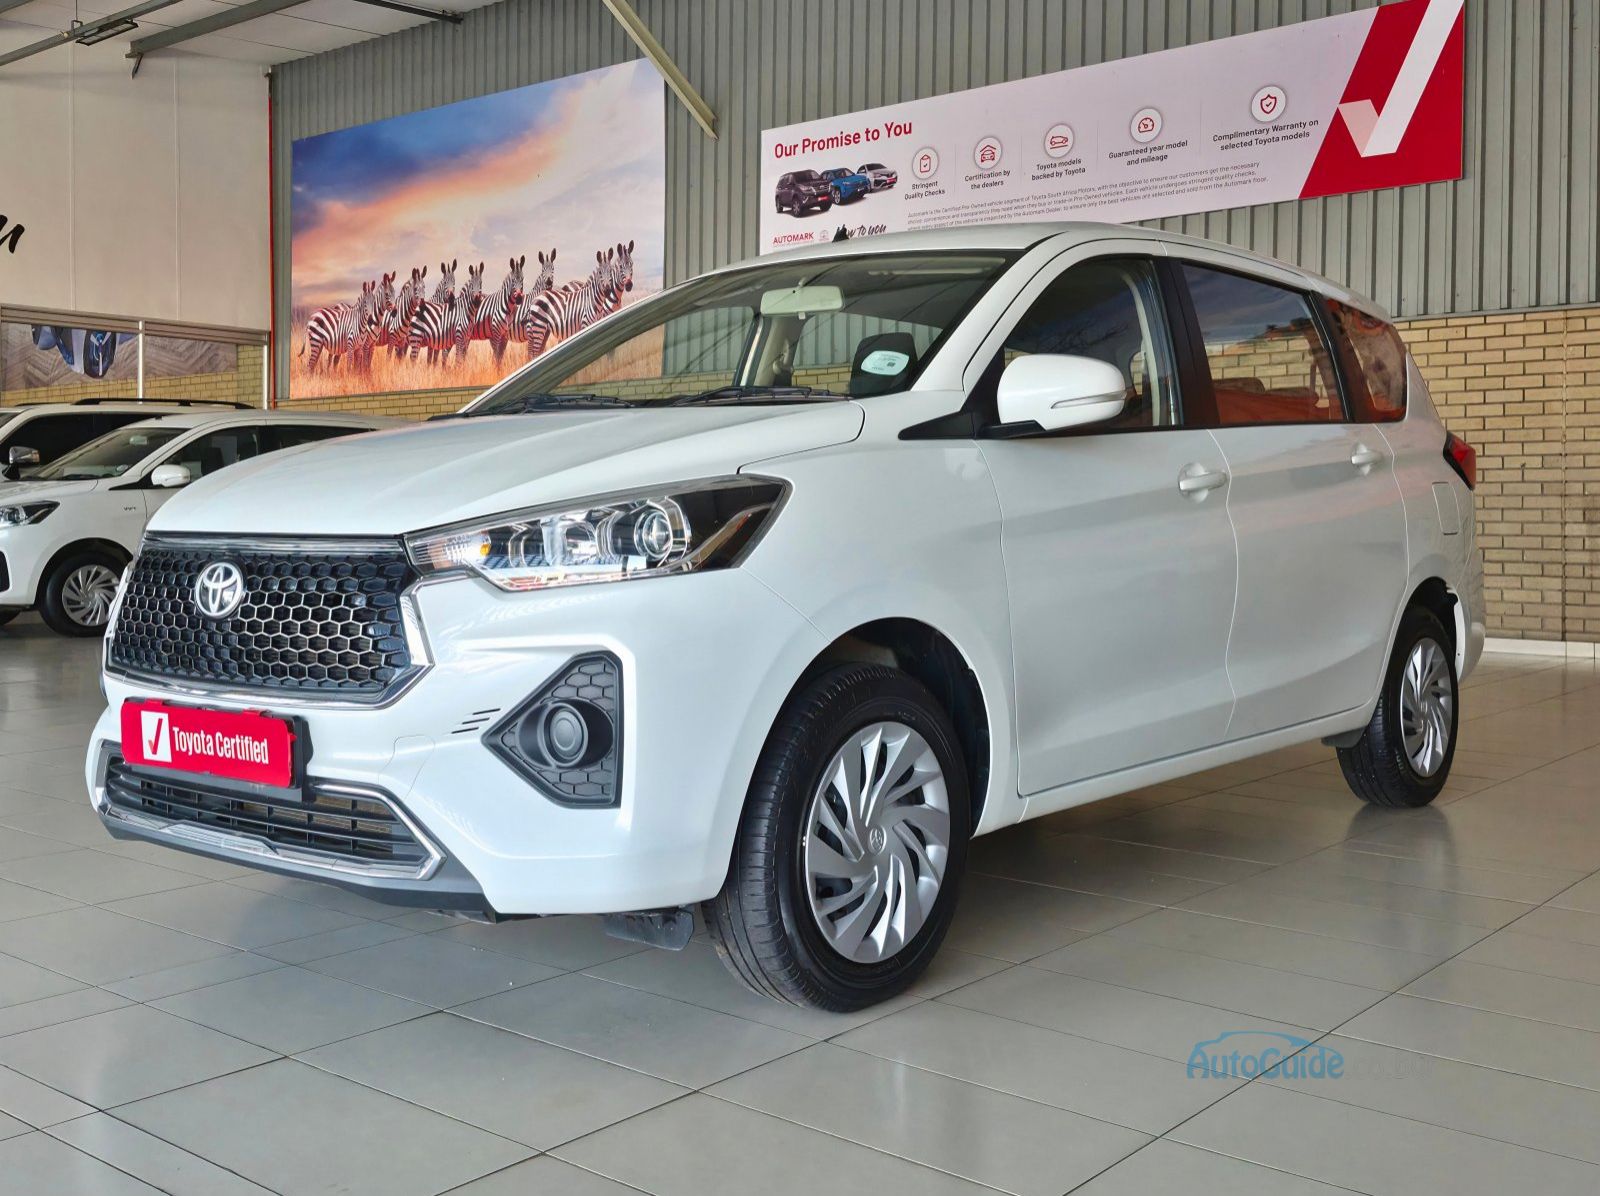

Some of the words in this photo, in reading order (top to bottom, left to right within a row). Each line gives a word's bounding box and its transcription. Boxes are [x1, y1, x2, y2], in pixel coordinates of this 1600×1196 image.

[1212, 128, 1270, 142] Complimentary
[1272, 122, 1307, 134] Warranty
[1308, 119, 1319, 127] on
[774, 143, 798, 158] Our
[802, 131, 861, 154] Promise
[865, 128, 880, 142] to
[884, 122, 912, 138] You
[1220, 140, 1253, 151] selected
[1254, 135, 1280, 146] Toyota
[1281, 130, 1310, 142] models
[1108, 147, 1148, 160] Guaranteed
[1148, 144, 1164, 154] year
[1165, 140, 1188, 150] model
[1036, 162, 1056, 172] Toyota
[1057, 158, 1082, 168] models
[1126, 157, 1139, 166] and
[1140, 154, 1168, 164] mileage
[964, 170, 1002, 182] Certification
[1003, 168, 1011, 178] by
[1031, 193, 1046, 201] Toyota
[1048, 190, 1061, 198] South
[1118, 179, 1142, 187] objective
[1179, 169, 1208, 178] customers
[1230, 161, 1260, 170] necessary
[1032, 172, 1054, 181] backed
[1055, 170, 1063, 178] by
[1064, 166, 1086, 176] Toyota
[911, 180, 938, 190] Stringent
[970, 182, 980, 190] the
[981, 179, 1004, 188] dealers
[1125, 186, 1138, 194] Each
[1140, 184, 1158, 192] vehicle
[1158, 180, 1187, 189] undergoes
[1188, 175, 1213, 184] stringent
[1214, 172, 1233, 182] quality
[1152, 189, 1174, 198] selected
[1224, 178, 1252, 187] Automark
[904, 191, 924, 200] Quality
[924, 188, 946, 197] Checks
[773, 232, 814, 244] AUTOMARK
[172, 726, 214, 756] Toyota
[215, 732, 269, 764] Certified
